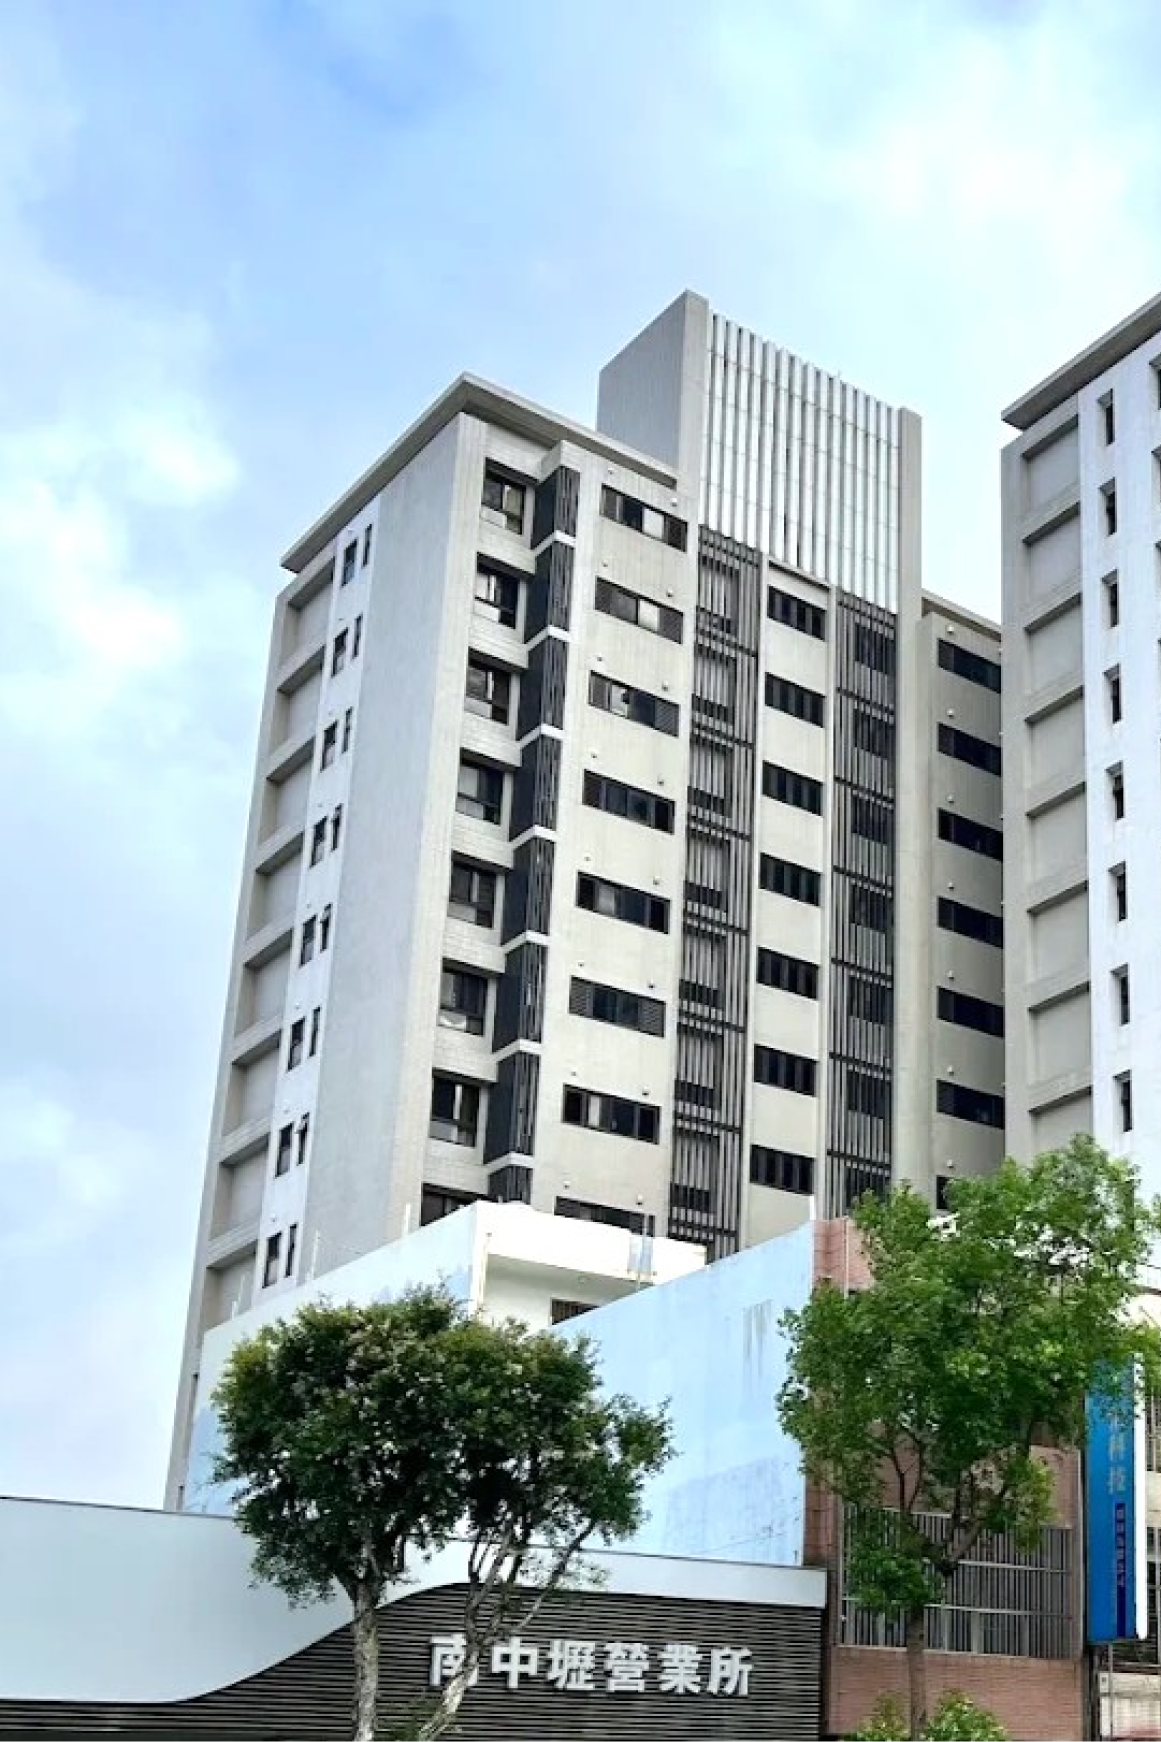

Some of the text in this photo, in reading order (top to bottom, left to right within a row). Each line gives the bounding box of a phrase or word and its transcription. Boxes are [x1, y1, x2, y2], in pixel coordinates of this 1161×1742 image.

[429, 1633, 753, 1697] 南中壢營業所
